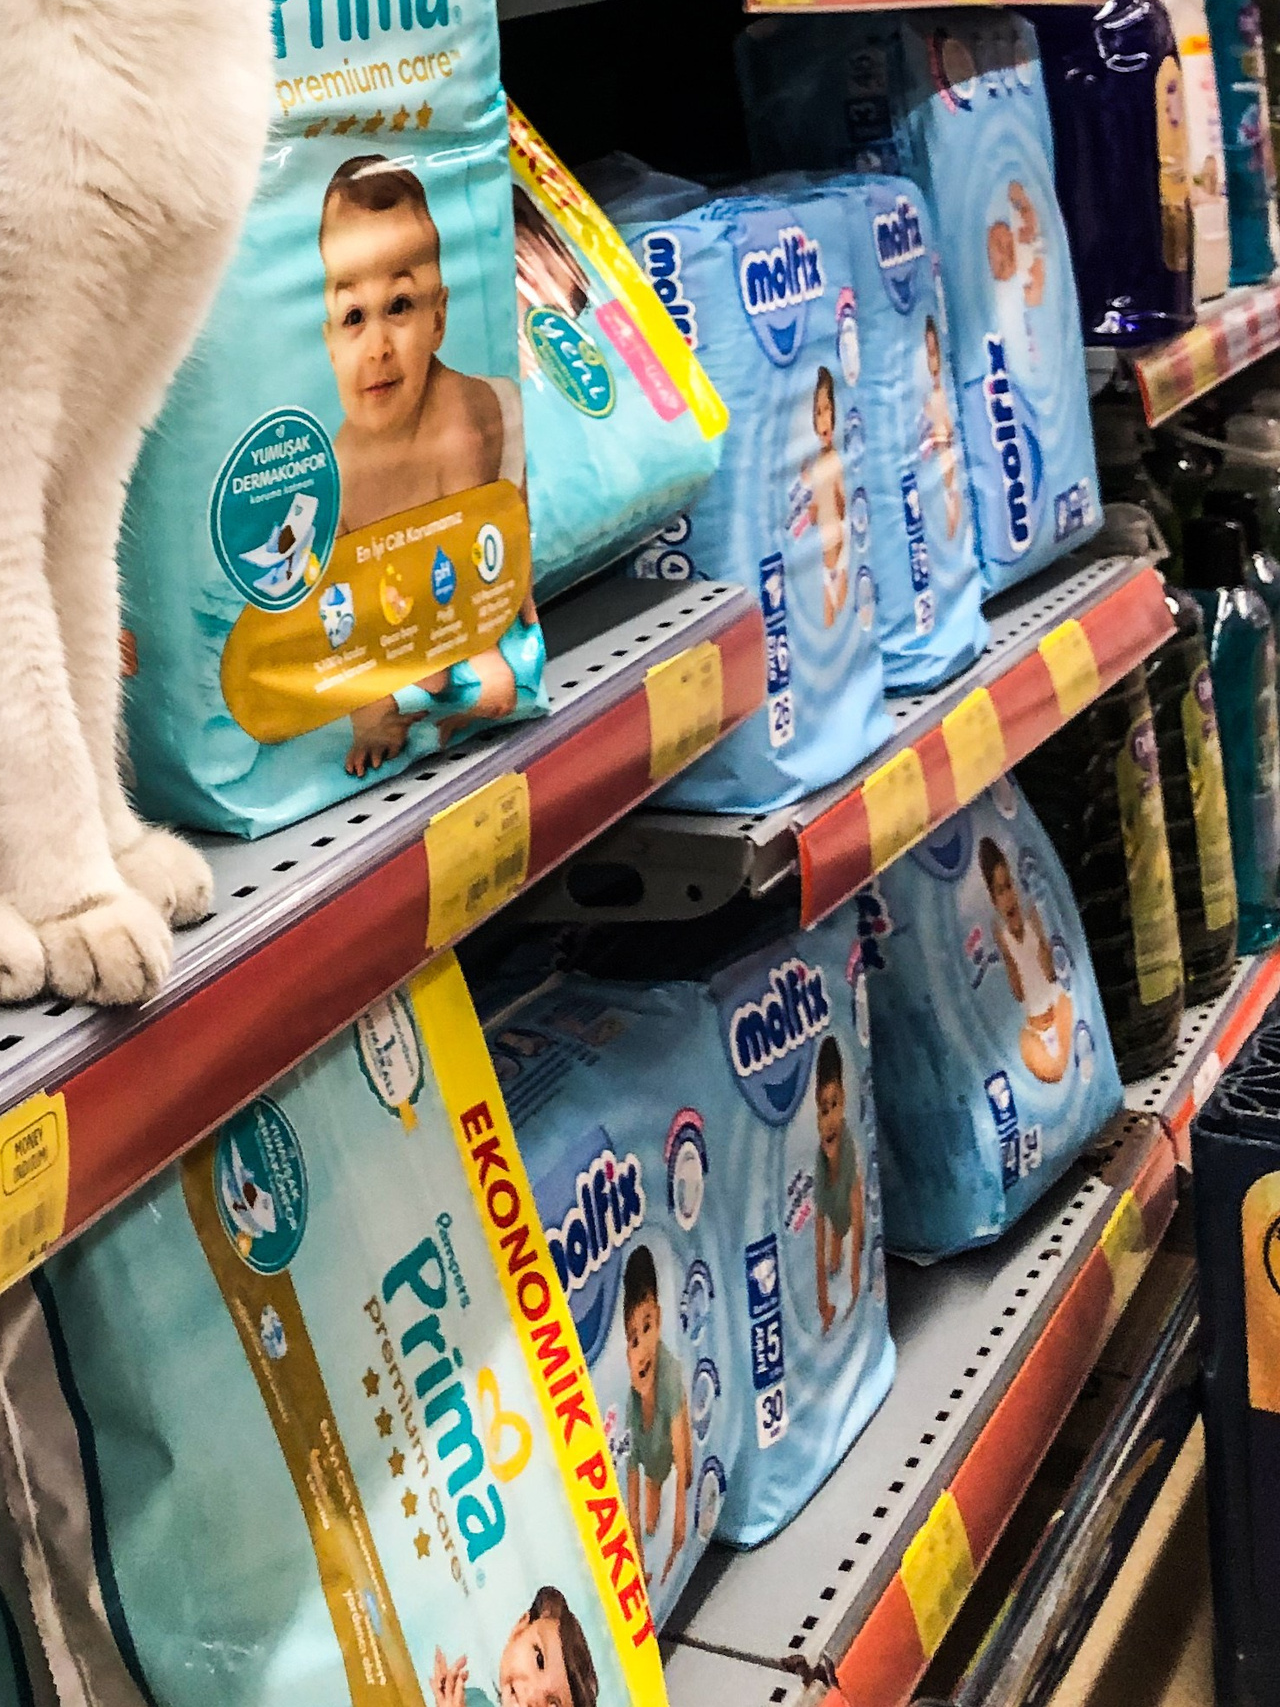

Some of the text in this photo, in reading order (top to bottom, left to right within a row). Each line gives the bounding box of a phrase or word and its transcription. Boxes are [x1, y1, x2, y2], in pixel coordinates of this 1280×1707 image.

[274, 50, 454, 117] premium care
[647, 237, 692, 350] molf
[746, 232, 821, 307] molfix
[231, 451, 327, 496] DERMAKONFOR
[250, 434, 312, 467] YUMUŞAK
[987, 337, 1031, 543] molfix
[736, 964, 829, 1069] molfix
[436, 1211, 472, 1311] Pampers
[459, 1101, 656, 1648] EKONOMİK PAKET
[766, 1320, 781, 1363] 5
[363, 1294, 465, 1582] premium care
[381, 1236, 507, 1564] Prima
[762, 1389, 783, 1430] 30
